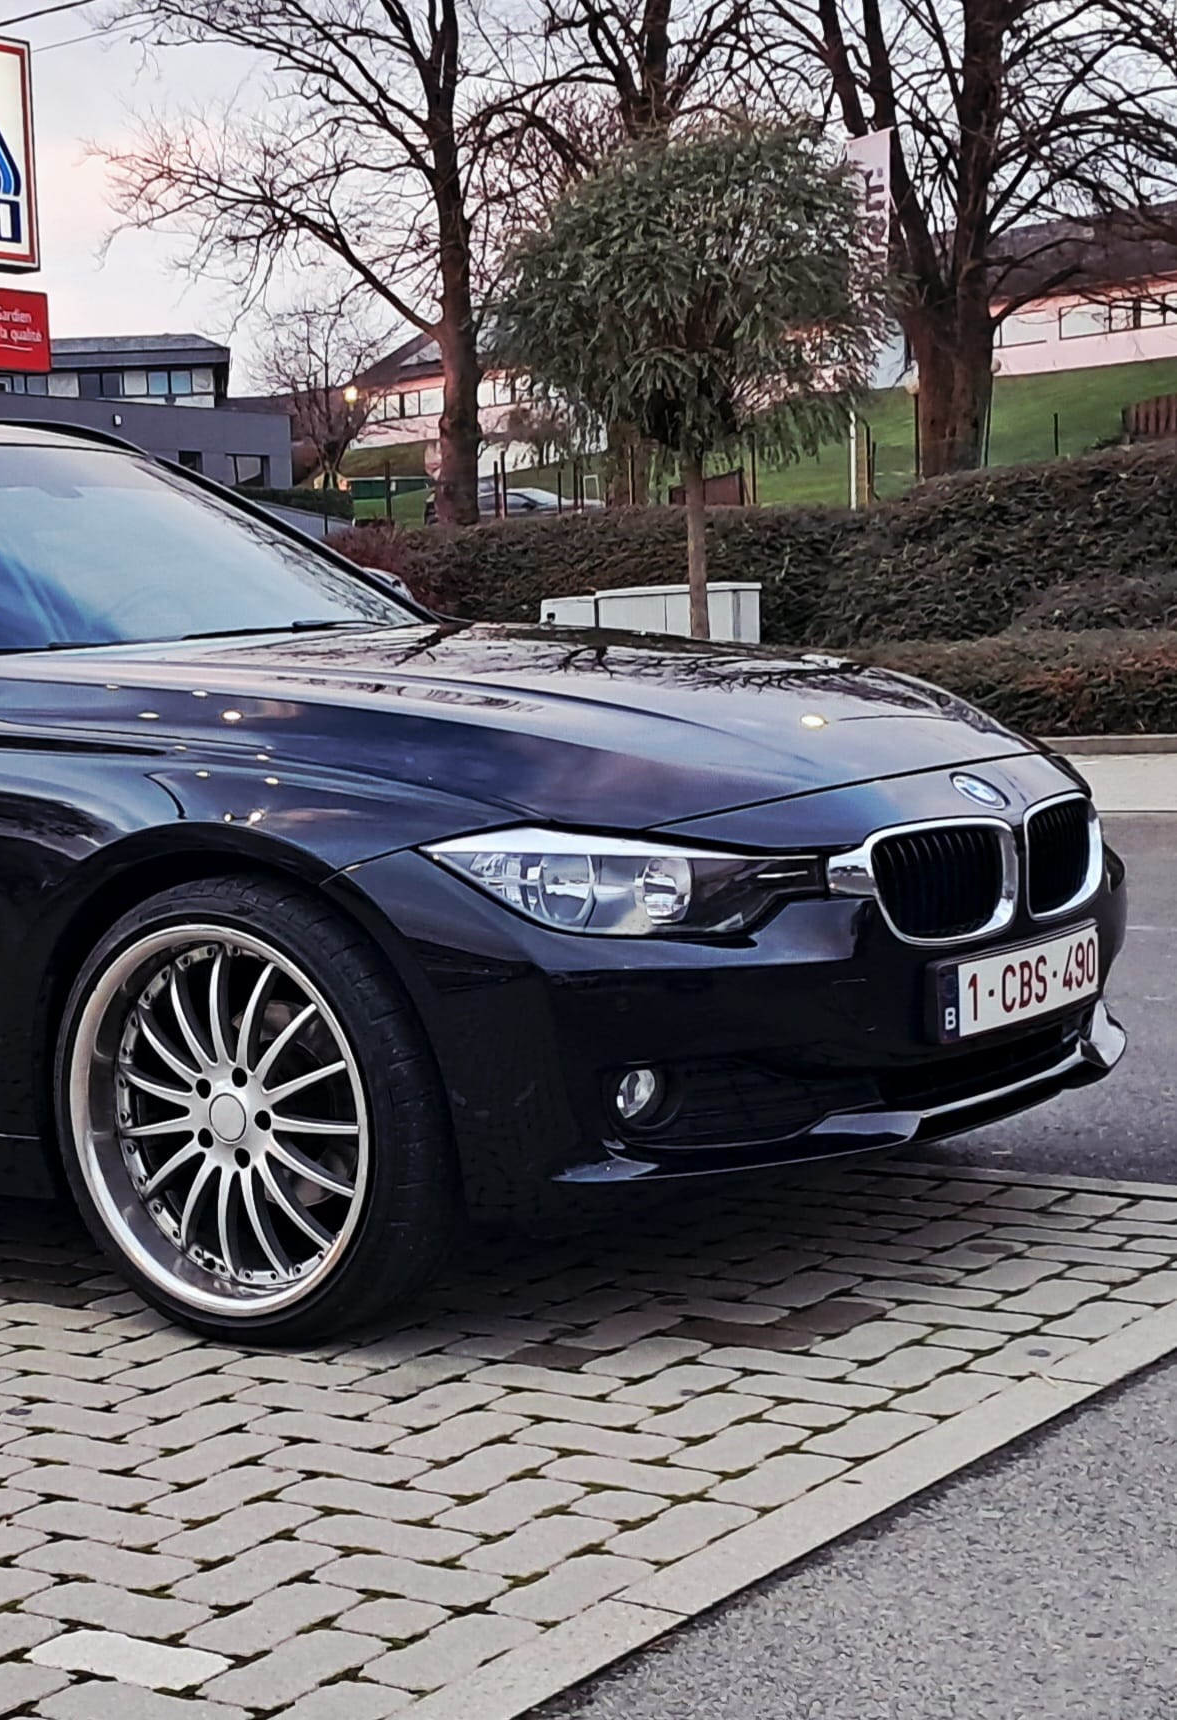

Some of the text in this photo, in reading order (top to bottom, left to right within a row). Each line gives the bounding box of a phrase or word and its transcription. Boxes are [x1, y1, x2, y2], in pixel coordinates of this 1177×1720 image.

[0, 324, 8, 339] la
[10, 325, 43, 344] qualité
[944, 1006, 957, 1031] B
